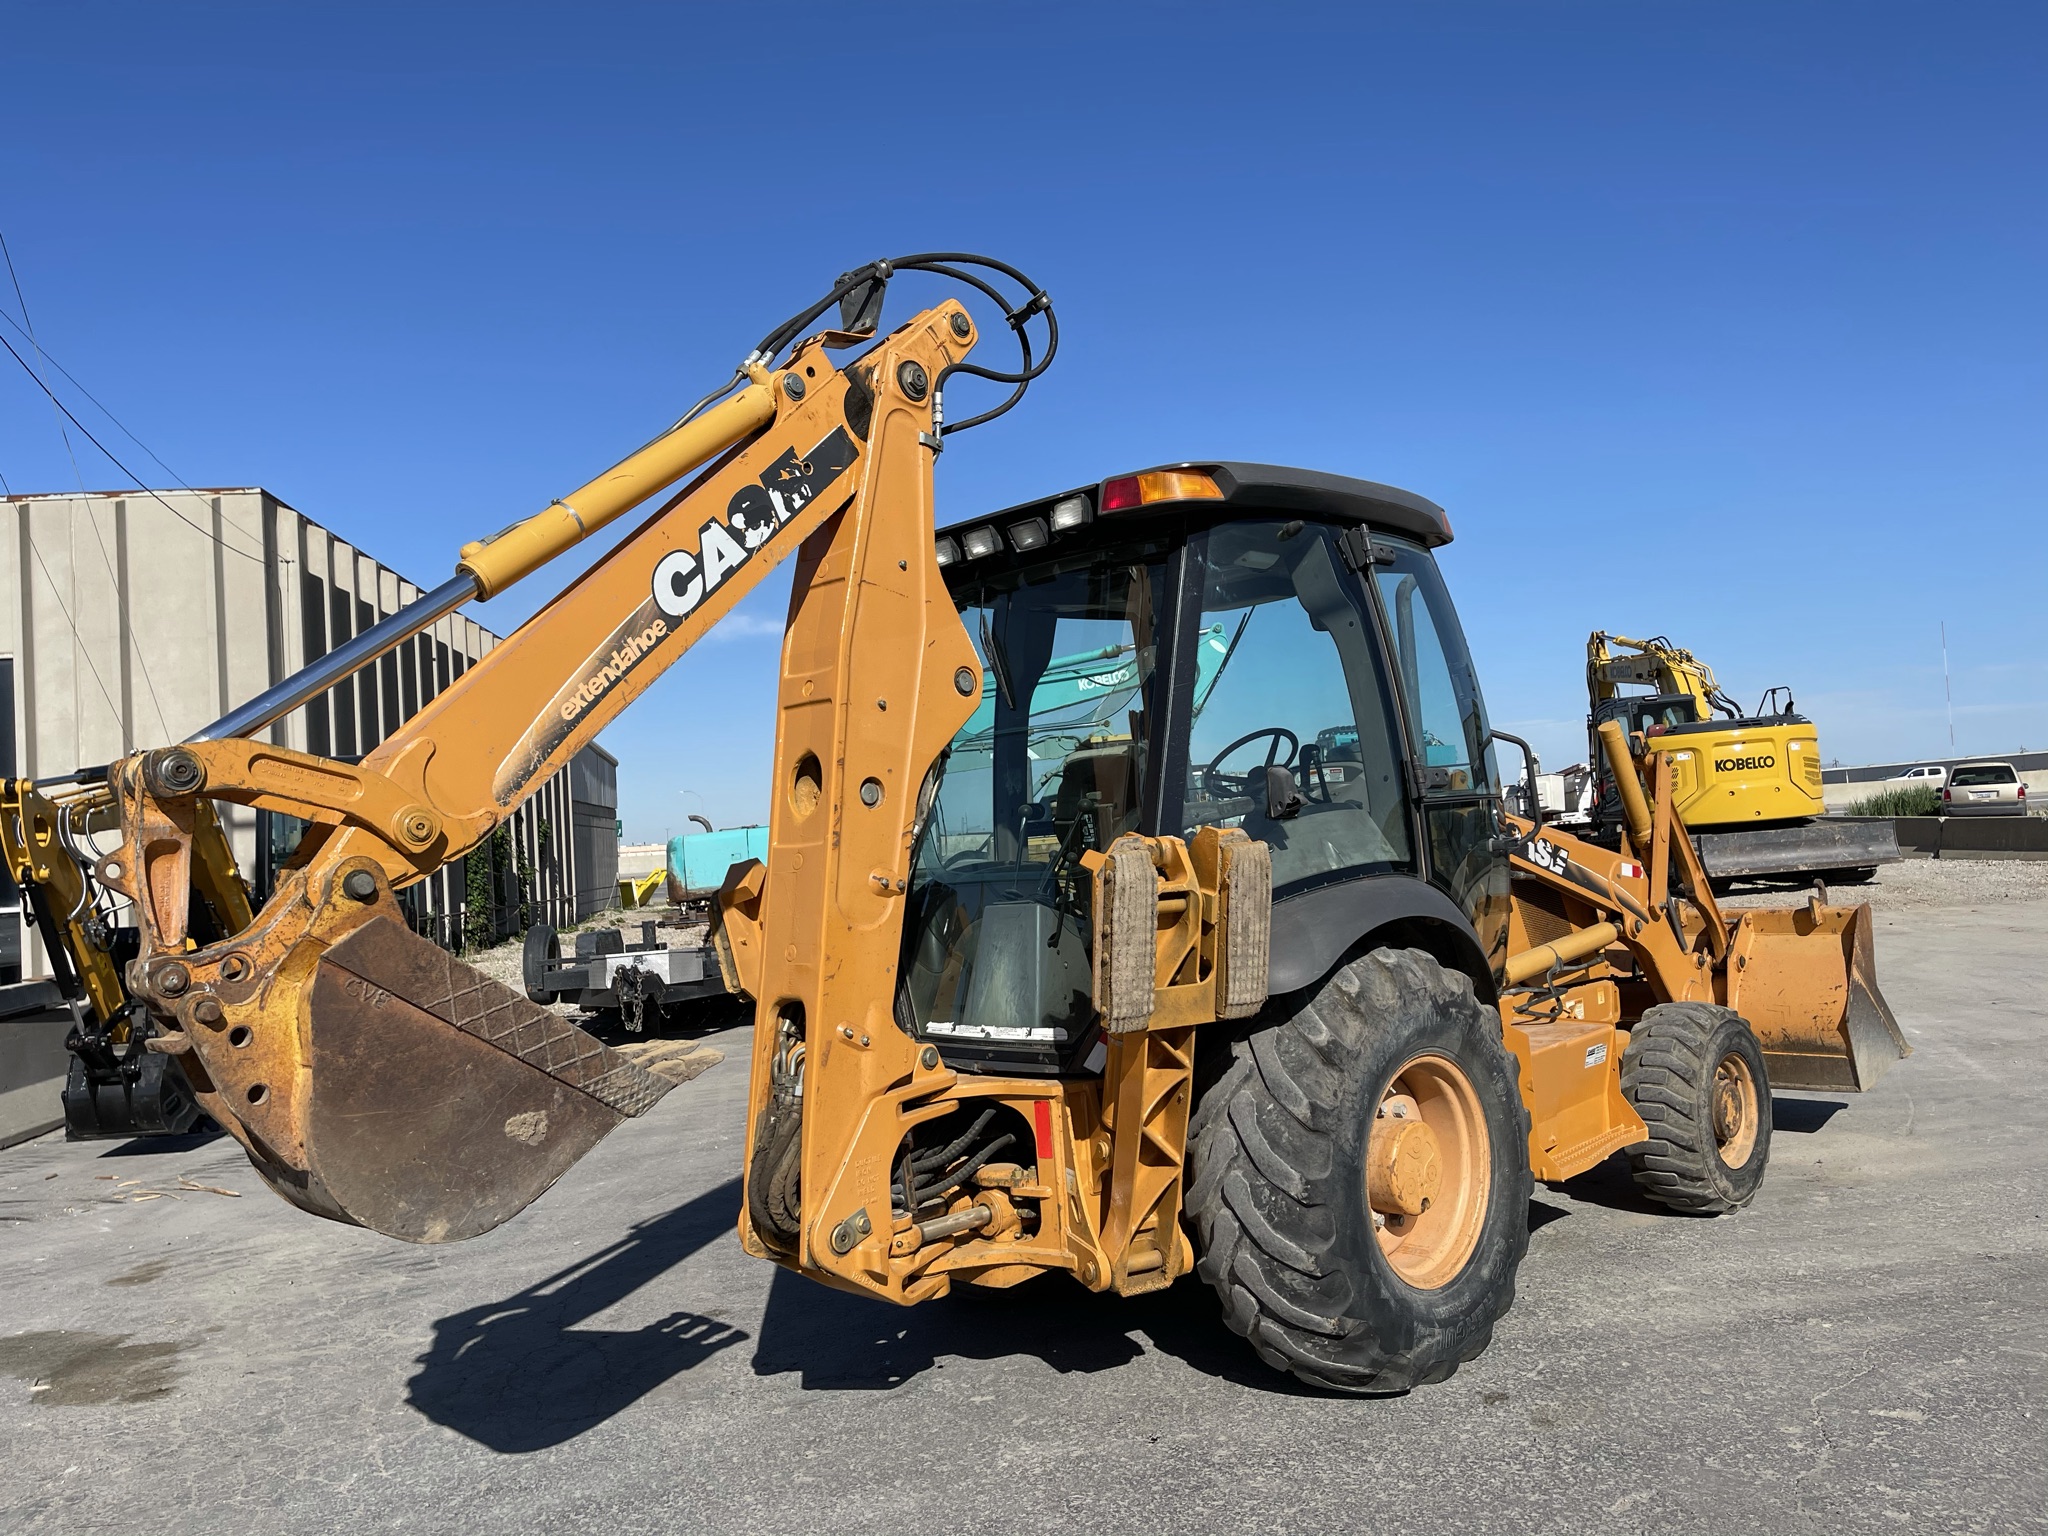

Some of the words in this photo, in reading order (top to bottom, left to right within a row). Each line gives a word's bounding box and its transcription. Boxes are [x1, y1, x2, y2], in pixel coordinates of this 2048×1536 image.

[561, 619, 667, 720] extendahoe
[1078, 669, 1130, 691] KOBELCO
[1715, 755, 1775, 773] KOBELCO
[1512, 827, 1568, 876] SE
